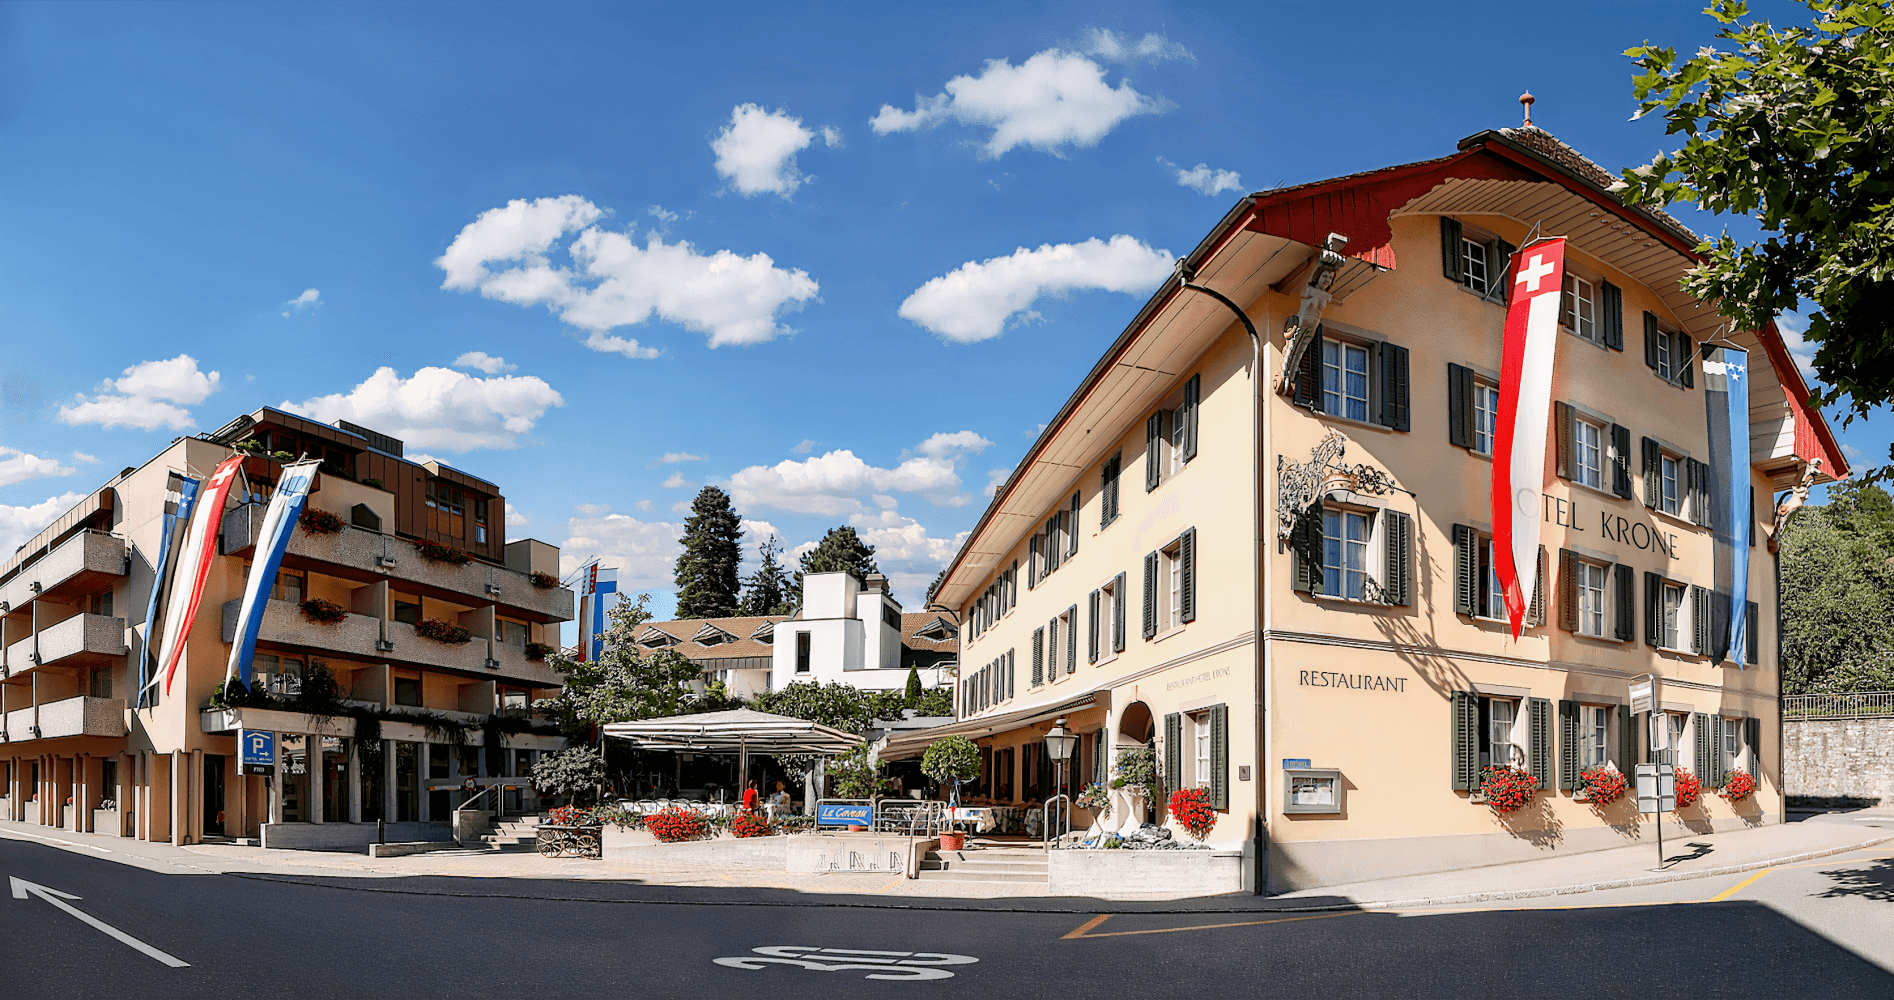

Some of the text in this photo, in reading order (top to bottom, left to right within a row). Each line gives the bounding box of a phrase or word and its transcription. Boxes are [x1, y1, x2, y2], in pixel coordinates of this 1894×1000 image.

[1517, 488, 1680, 560] OTEL KRONE
[1300, 670, 1408, 693] RESTAURANT
[253, 738, 264, 754] P
[822, 807, 868, 818] Le Caveau
[712, 945, 980, 981] 30
